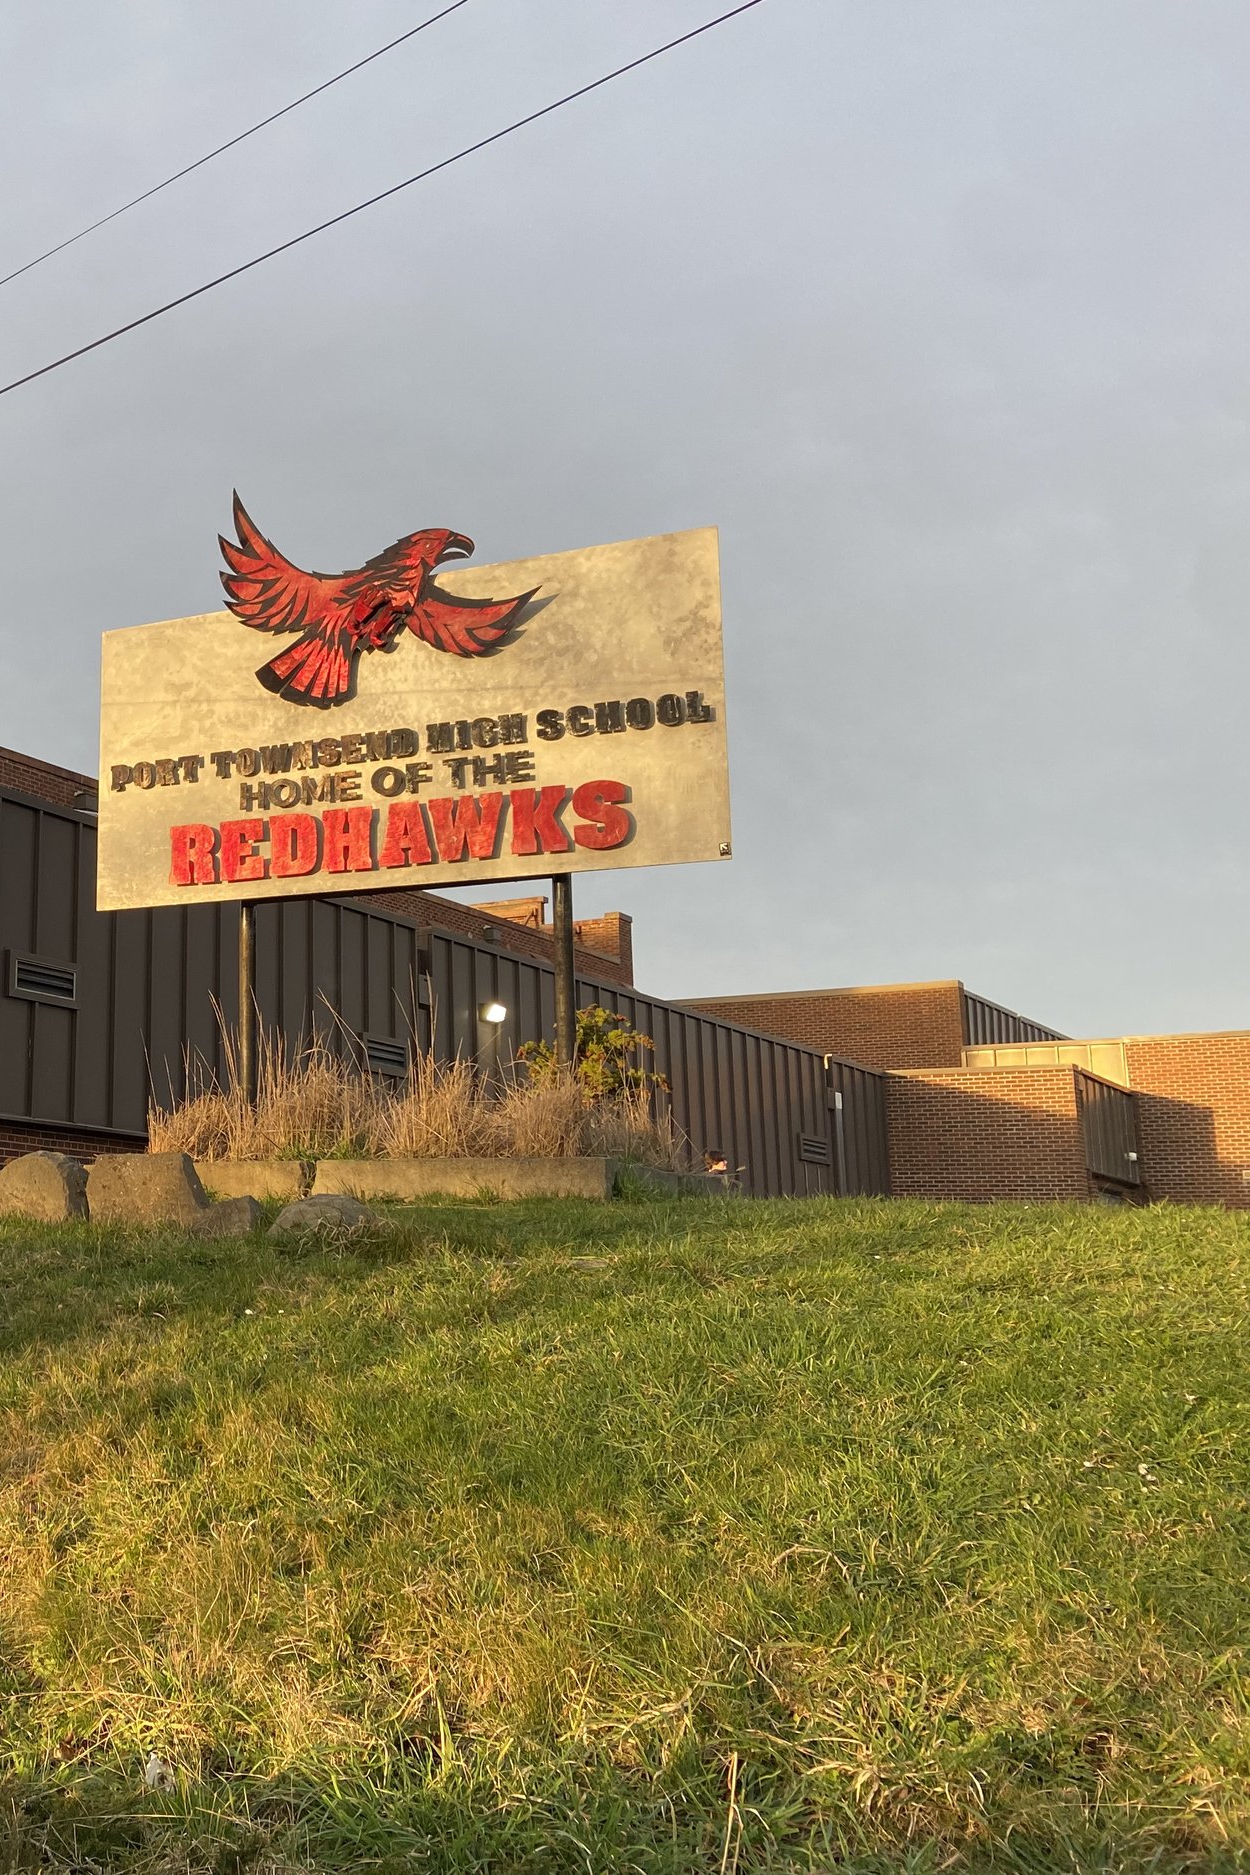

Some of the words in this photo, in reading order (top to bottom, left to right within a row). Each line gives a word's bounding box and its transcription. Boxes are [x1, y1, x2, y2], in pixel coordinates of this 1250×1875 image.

[111, 755, 202, 791] PORT
[211, 728, 418, 779] TOWNSEND
[426, 713, 527, 753] HIGH
[536, 691, 714, 740] SCHOOL
[240, 770, 363, 811] HOME
[371, 762, 432, 796] OF
[443, 750, 535, 788] THE
[169, 780, 634, 886] REDHAWKS
